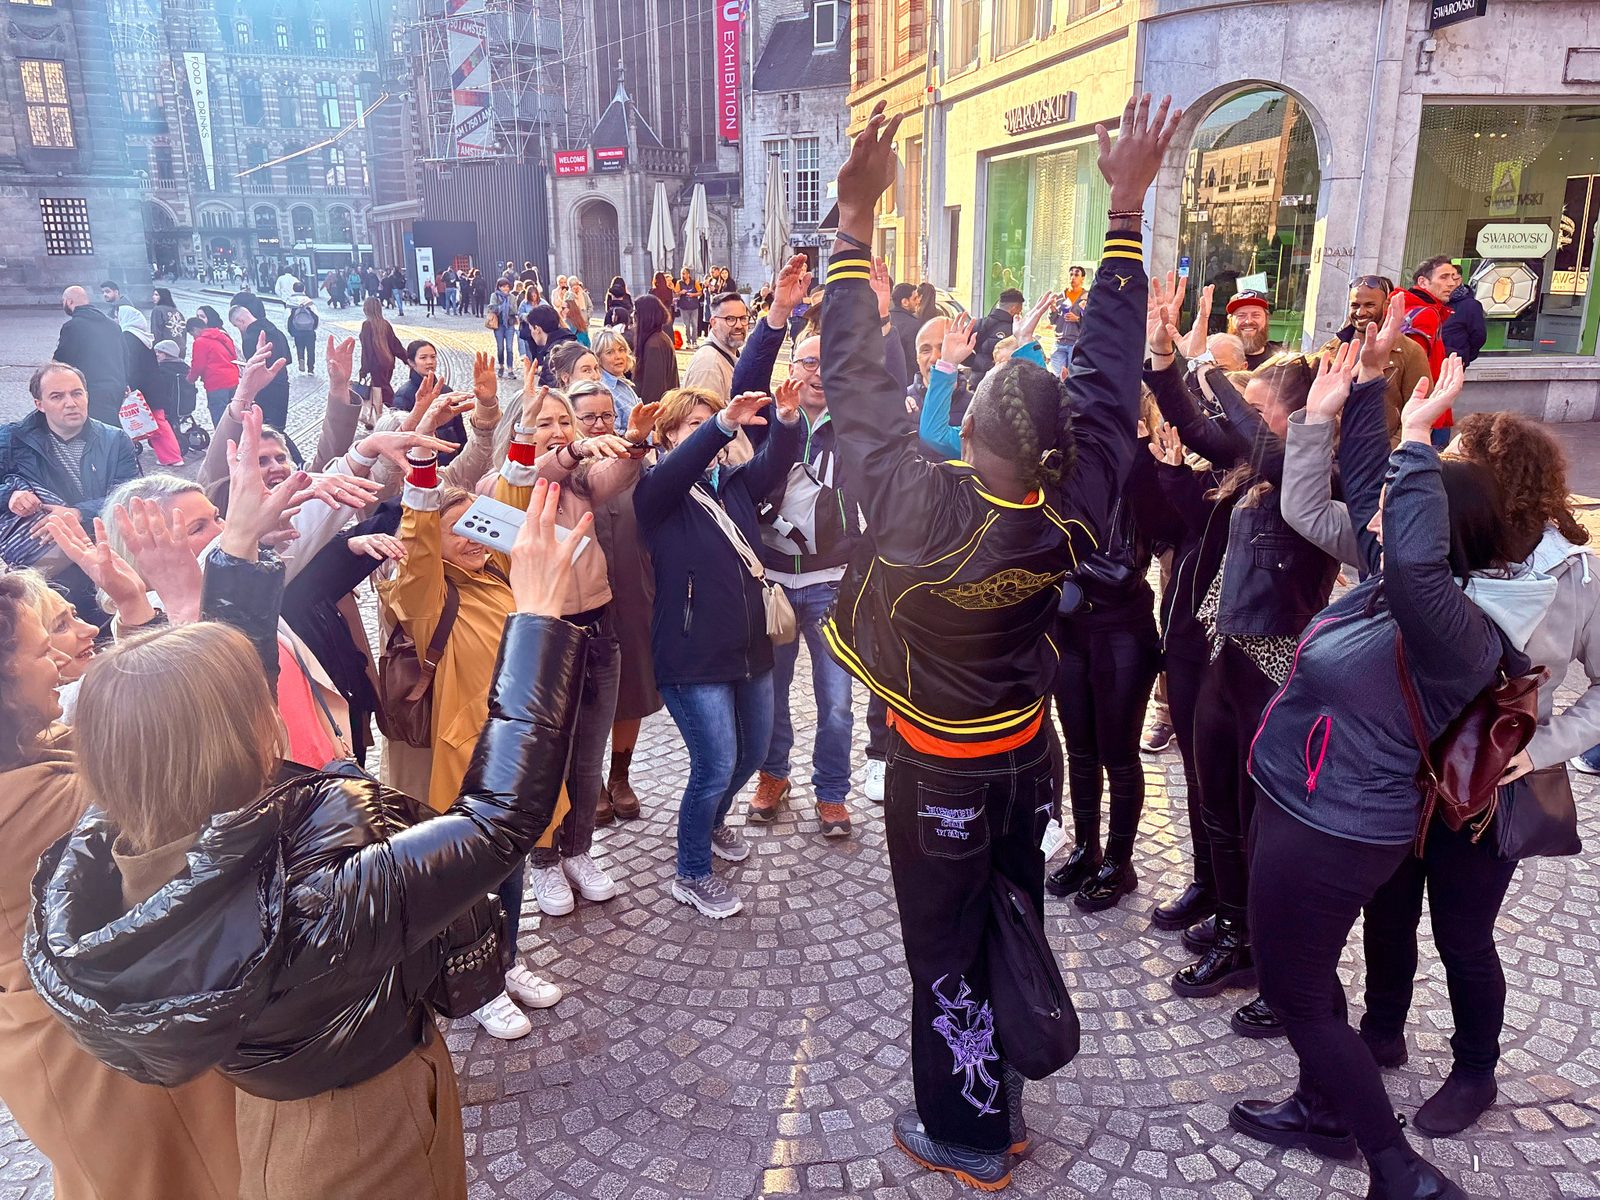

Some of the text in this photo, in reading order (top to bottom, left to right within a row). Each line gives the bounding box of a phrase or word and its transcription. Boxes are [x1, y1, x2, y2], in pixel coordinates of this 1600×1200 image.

[1433, 0, 1475, 19] SWAROVSKI
[723, 30, 737, 130] EXHIBITION
[191, 56, 202, 85] FOOD
[197, 101, 210, 139] DRINKS
[1004, 94, 1067, 131] SWAROVSKI
[558, 155, 586, 164] WELCOME
[1482, 232, 1548, 244] SWAROVSKI
